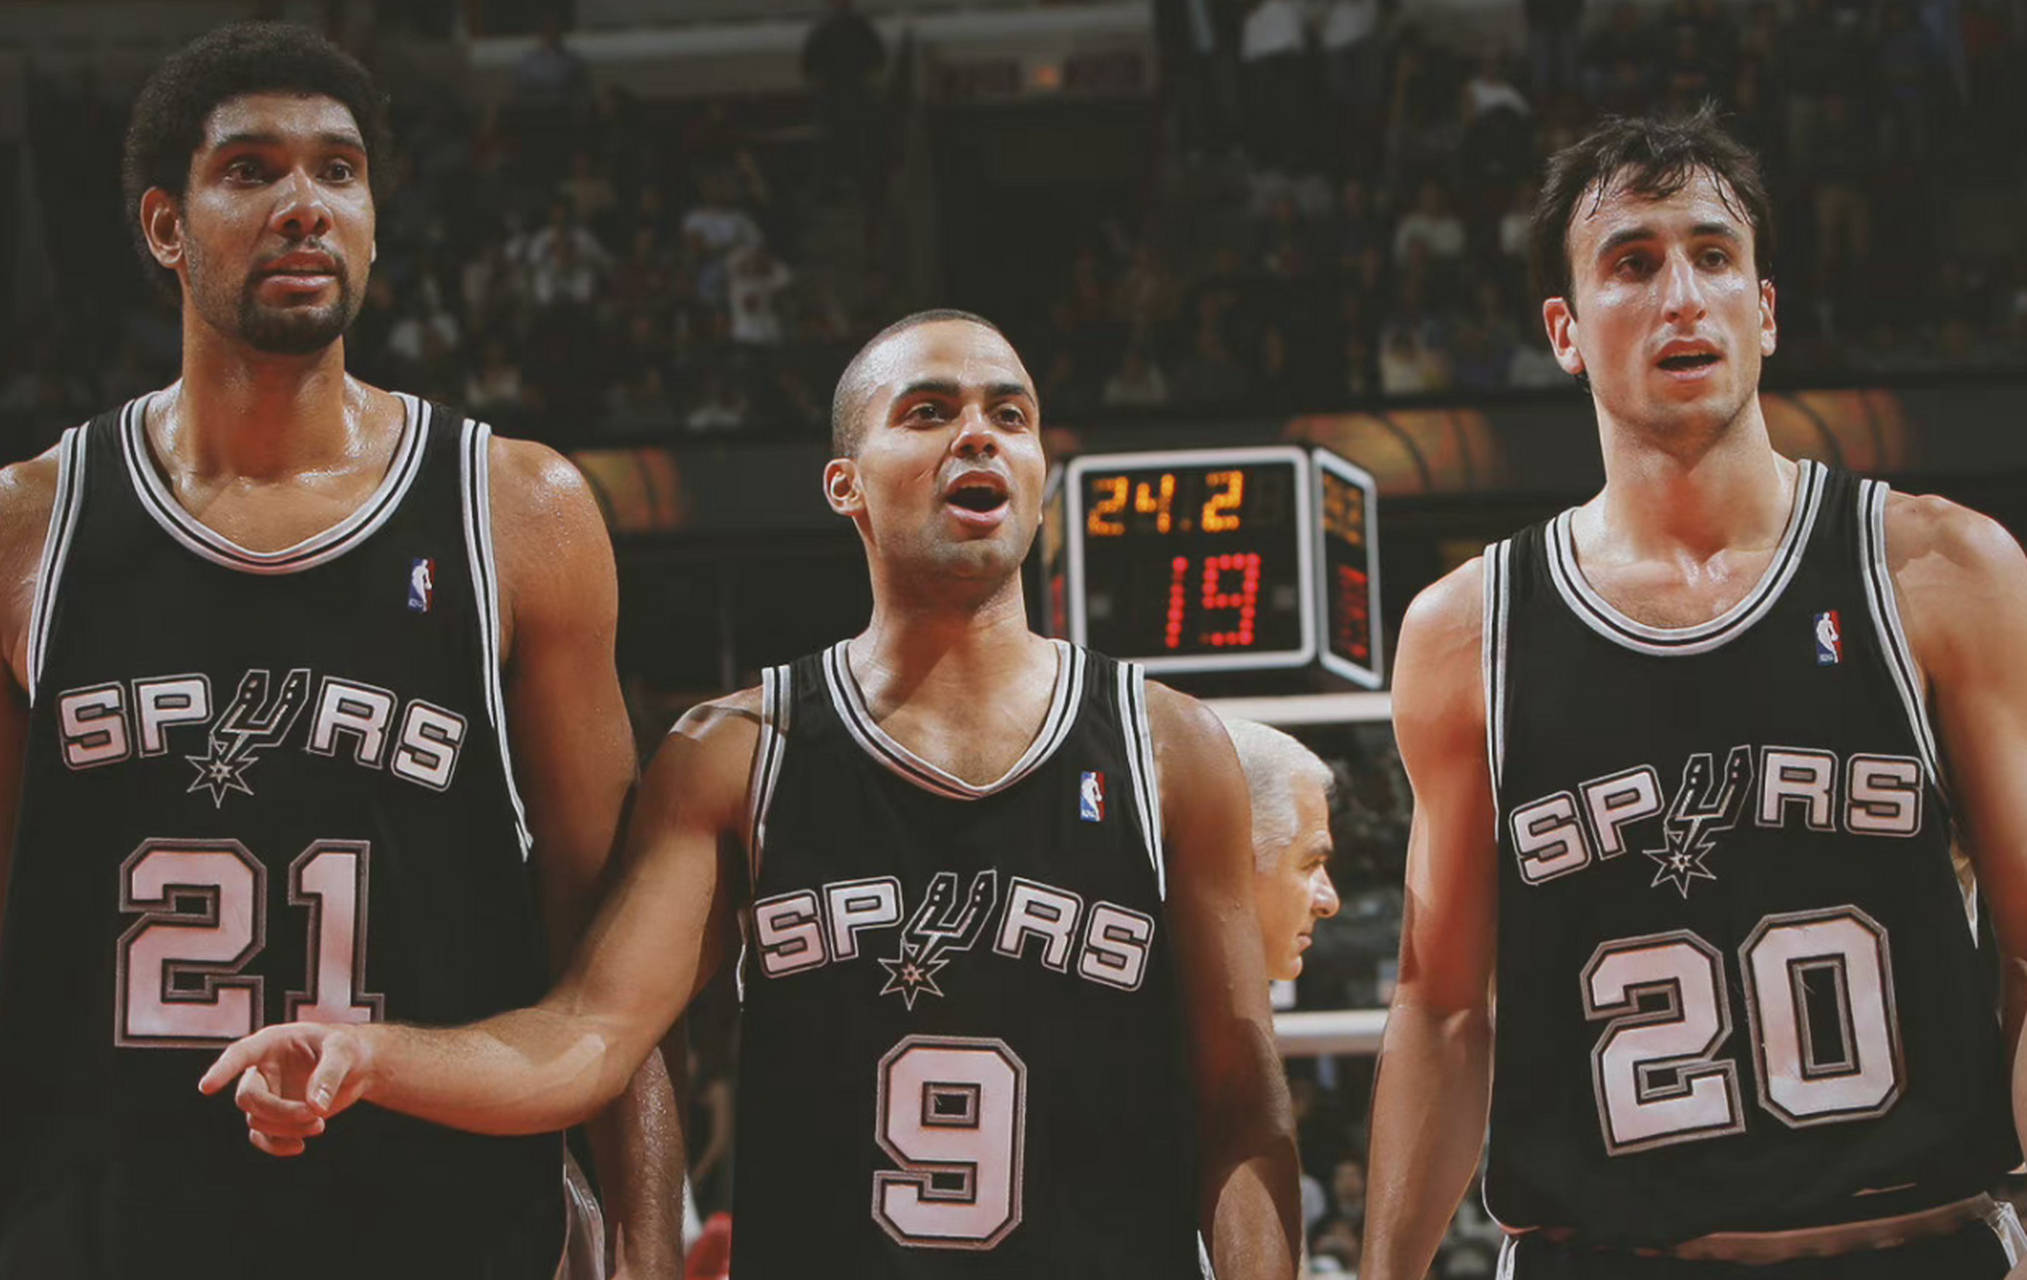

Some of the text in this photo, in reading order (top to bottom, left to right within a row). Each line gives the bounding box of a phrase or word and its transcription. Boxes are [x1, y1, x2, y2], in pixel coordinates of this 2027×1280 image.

[1165, 552, 1260, 648] 19
[57, 669, 468, 808] SPURS
[1508, 744, 1926, 899] SPURS
[115, 837, 385, 1048] 21
[754, 867, 1155, 1011] SPURS
[1579, 904, 1907, 1157] 20
[871, 1034, 1027, 1251] 9
